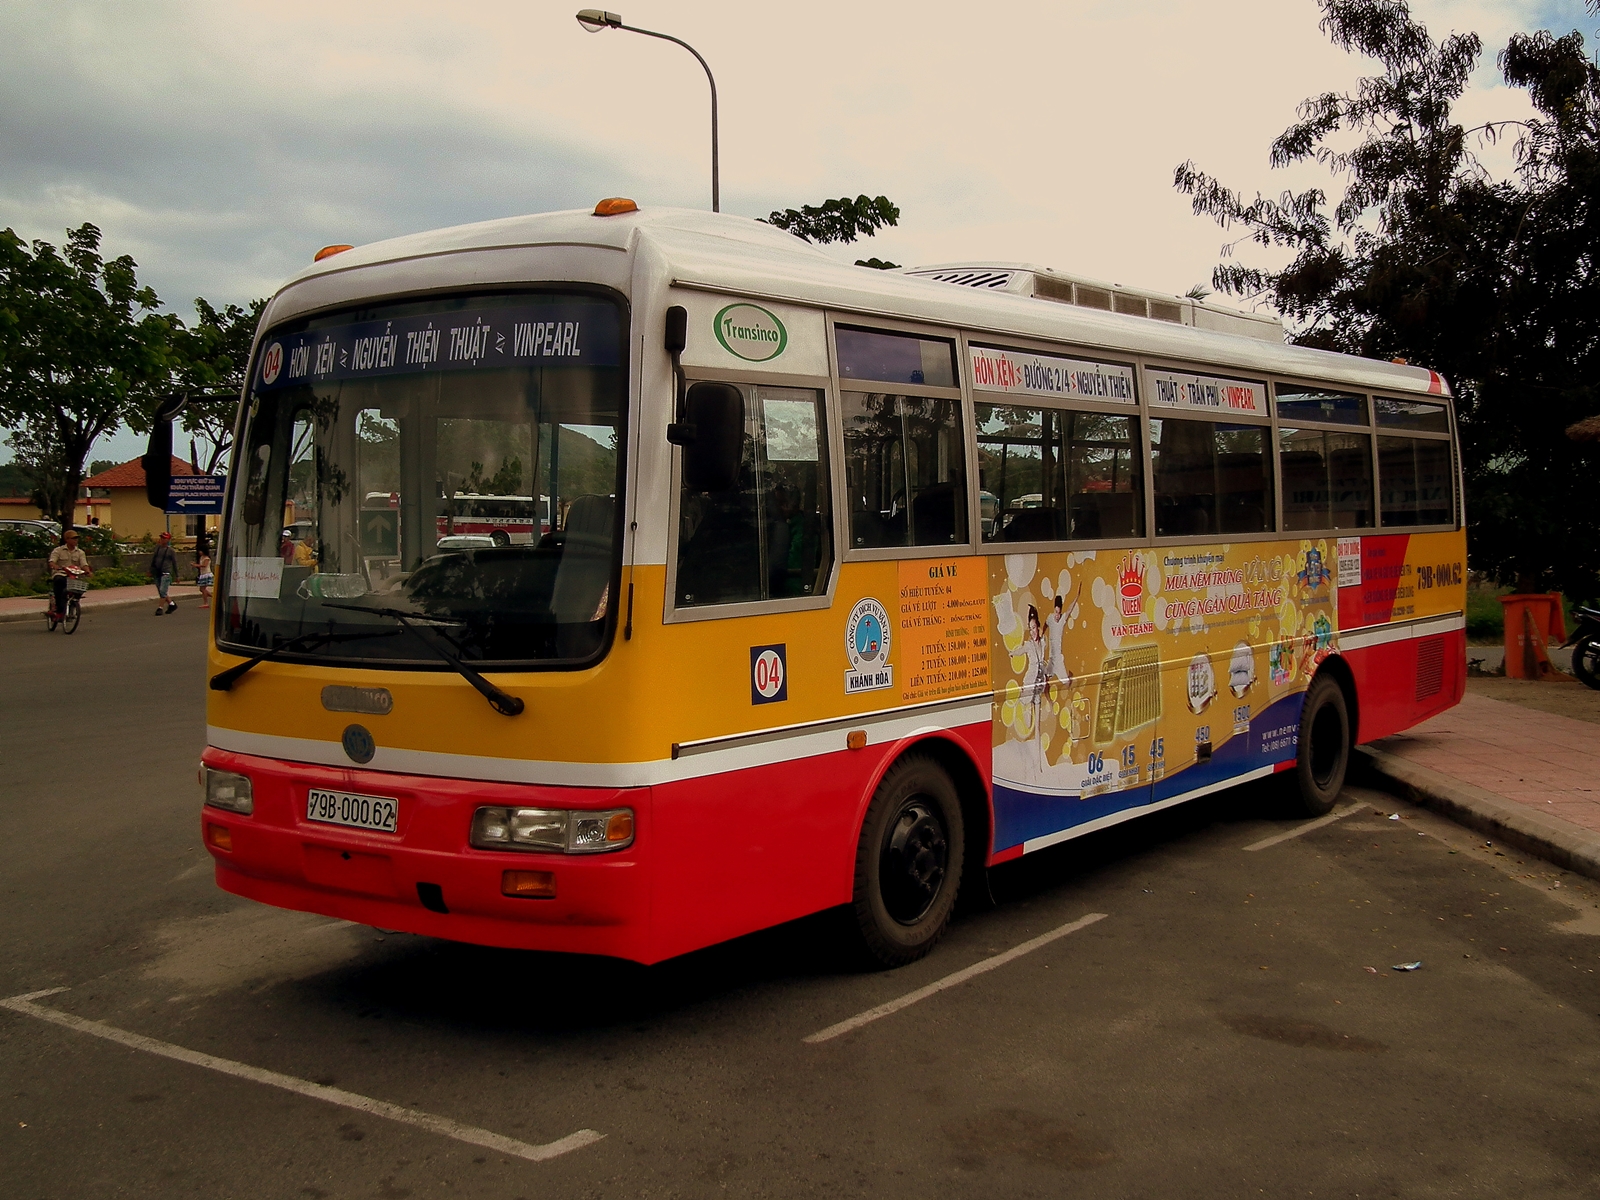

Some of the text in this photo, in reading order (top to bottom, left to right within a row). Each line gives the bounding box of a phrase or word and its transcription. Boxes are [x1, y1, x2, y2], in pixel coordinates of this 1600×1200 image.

[723, 317, 779, 342] Transinco
[263, 350, 280, 379] 04
[288, 339, 310, 378] HÒN
[351, 322, 398, 371] NGUYỄN
[405, 322, 441, 370] THIỆN
[449, 317, 490, 366] THUẬT
[513, 322, 581, 357] VINPEARL
[973, 350, 995, 385] HÒN
[1024, 358, 1053, 391] ĐƯỜNG
[1054, 367, 1070, 393] 2/4
[1076, 364, 1108, 397] NGUYỄN
[1108, 371, 1132, 402] THIỆN
[1156, 376, 1178, 407] THUẬT
[1206, 381, 1220, 407] PHÚ
[1226, 385, 1256, 410] VINPEARL
[929, 562, 958, 578] GIÁ VÉ
[1164, 574, 1188, 592] MUA
[1189, 570, 1211, 591] NỆM
[1243, 555, 1282, 584] VÀNG
[900, 585, 908, 598] SỐ
[909, 586, 923, 598] HIỆU
[946, 586, 952, 594] 04
[1164, 585, 1282, 619] CÙNG NGÀN QUÀ TẶNG
[900, 602, 912, 614] GIÁ
[912, 602, 920, 612] VÉ
[922, 601, 937, 613] LƯỢT
[1122, 597, 1142, 616] QUEEN
[848, 624, 856, 649] CÔNG
[853, 611, 860, 623] TY
[858, 603, 872, 615] DỊCH
[872, 604, 880, 617] VỤ
[901, 617, 912, 628] GIÁ
[914, 618, 922, 627] VÉ
[922, 614, 942, 626] THÁNG
[757, 657, 780, 691] 04
[922, 660, 925, 670] 2
[850, 671, 889, 689] KHÁNH HÒA
[910, 674, 925, 687] LIÊN
[1195, 725, 1210, 742] 450
[1262, 724, 1298, 740] www.nemv
[1122, 744, 1135, 766] 15
[1150, 737, 1164, 758] 45
[1088, 750, 1104, 775] 06
